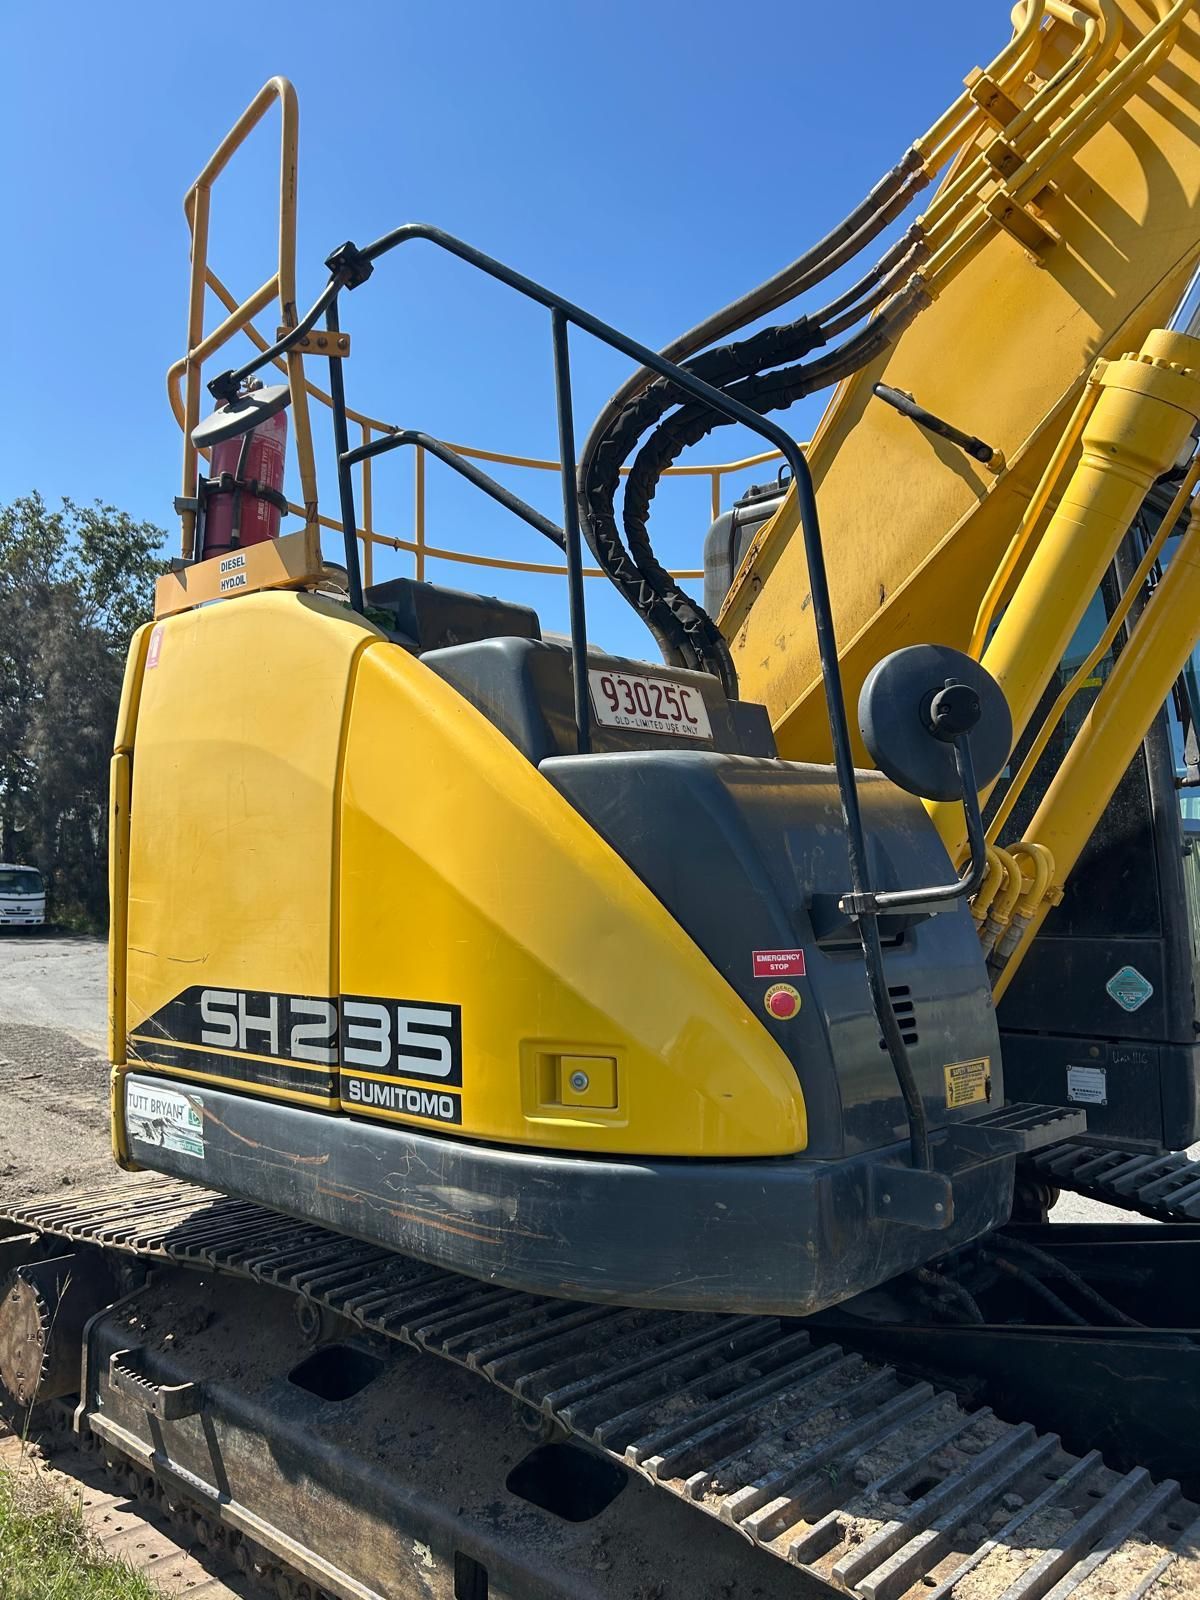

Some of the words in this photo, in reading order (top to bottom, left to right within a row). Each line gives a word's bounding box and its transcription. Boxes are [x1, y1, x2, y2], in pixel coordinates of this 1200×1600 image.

[221, 556, 245, 572] DIESEL
[221, 575, 246, 590] HYD.OIL
[600, 677, 698, 724] 93025C
[666, 721, 681, 732] USE
[682, 724, 698, 735] ONLY
[756, 953, 801, 962] EMERGENCY
[766, 985, 795, 1002] EMERGENCY
[128, 1093, 149, 1112] TUTT
[150, 1098, 185, 1120] BRYANT
[349, 1080, 454, 1118] SUMITOMO
